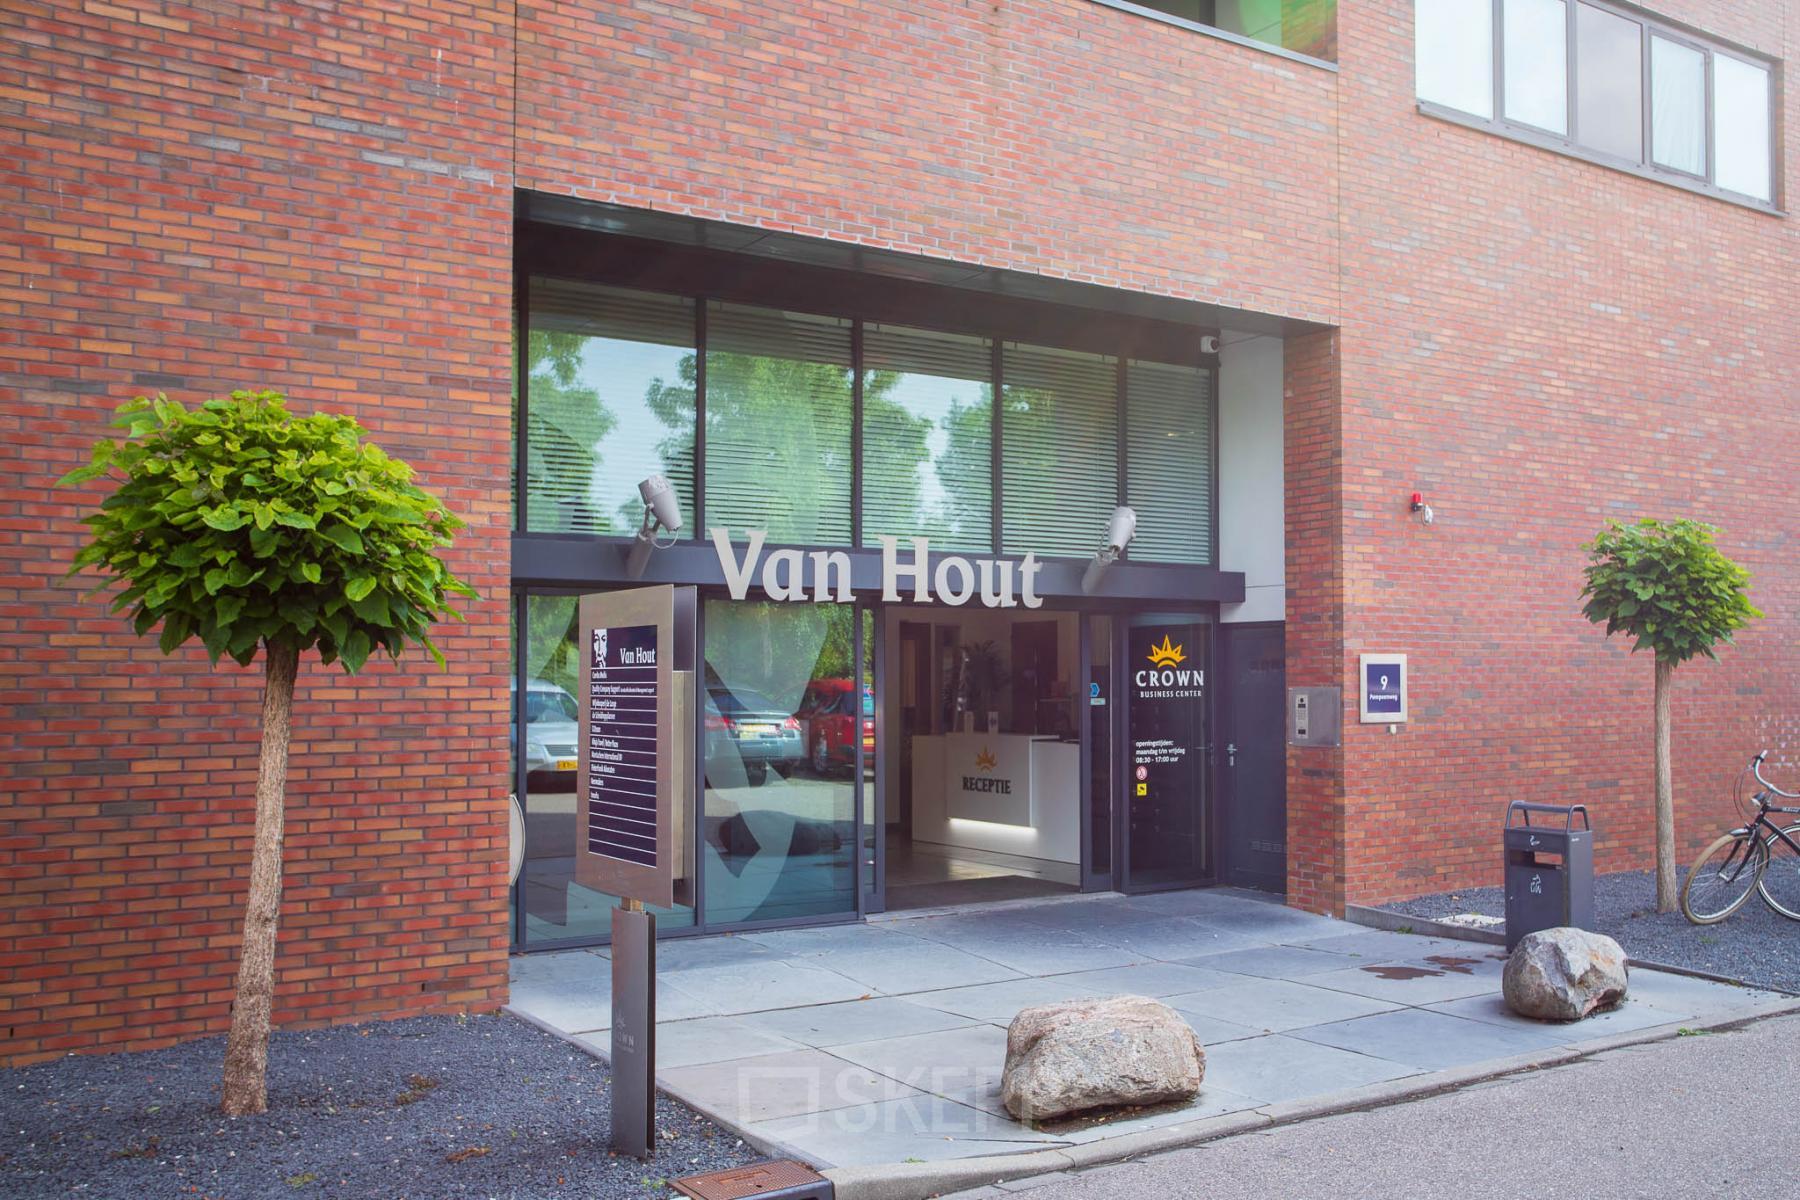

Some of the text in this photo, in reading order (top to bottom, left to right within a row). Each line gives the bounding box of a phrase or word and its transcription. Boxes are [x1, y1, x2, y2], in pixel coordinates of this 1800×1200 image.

[709, 527, 1044, 609] Van Hout
[620, 647, 656, 665] Van Hout
[1136, 670, 1204, 687] CROWN
[1381, 675, 1388, 690] 9
[1140, 690, 1174, 698] BUSINESS
[1169, 747, 1185, 755] vrijdag
[962, 777, 1011, 794] RECEPTIE
